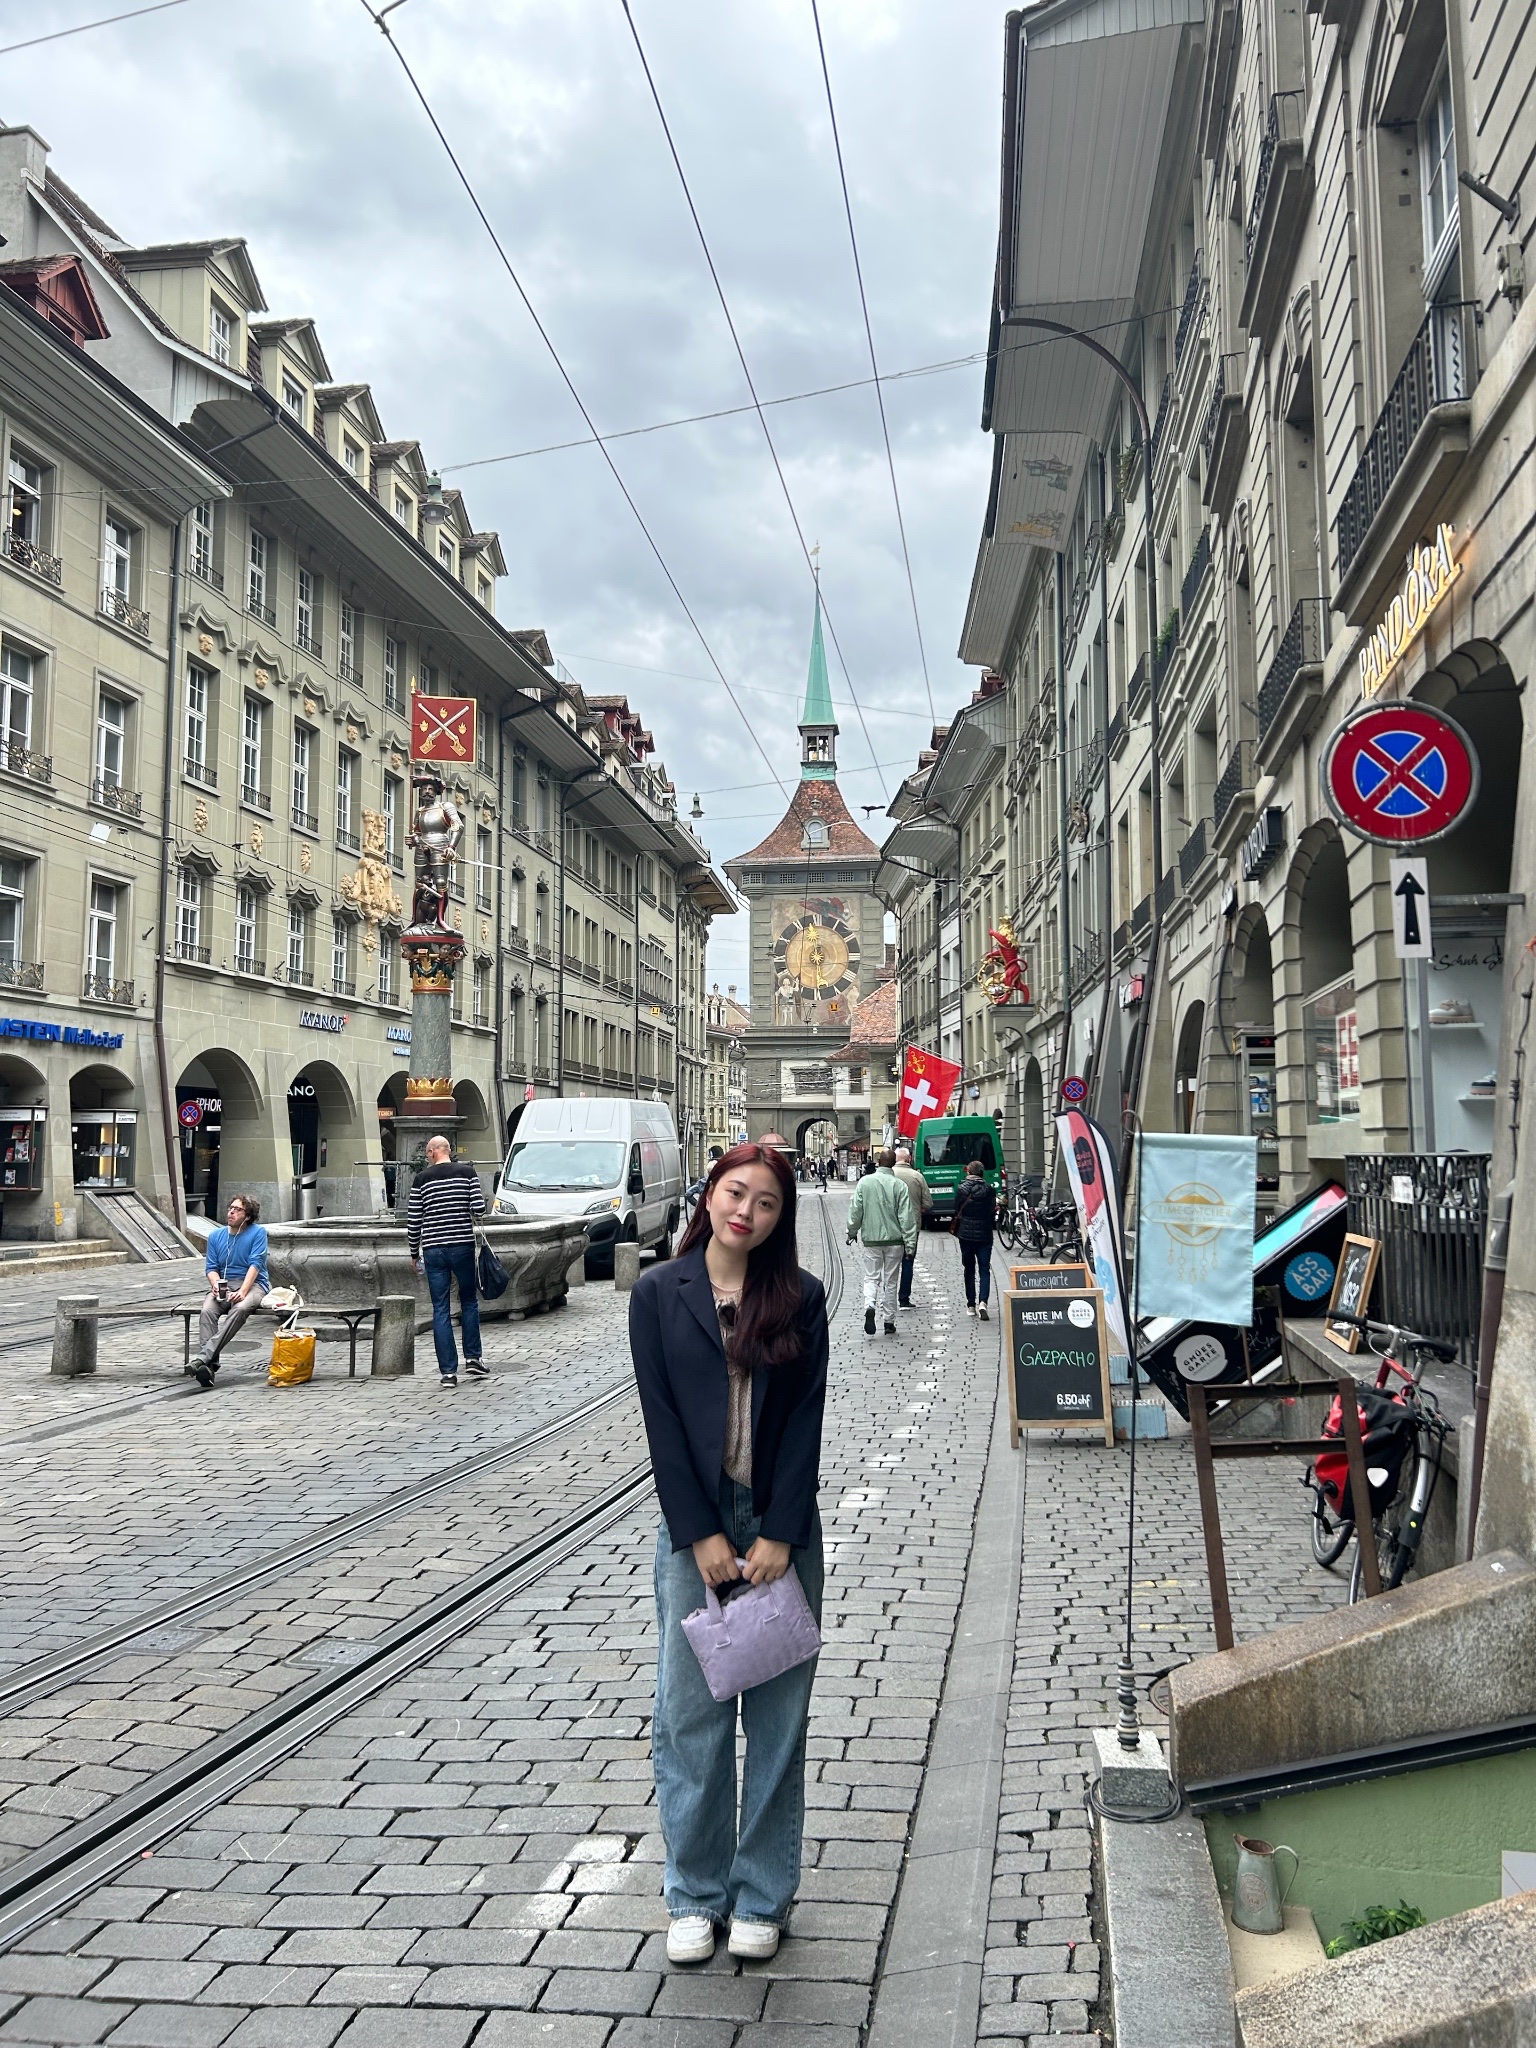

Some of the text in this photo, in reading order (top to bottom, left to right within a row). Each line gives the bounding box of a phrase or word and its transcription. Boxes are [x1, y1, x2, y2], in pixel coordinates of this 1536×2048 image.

[1358, 523, 1456, 699] PANDORA
[1433, 954, 1479, 971] Schuh
[300, 1009, 345, 1033] MANOR
[1289, 1256, 1319, 1286] ÄSS
[1301, 1268, 1332, 1296] BAR
[1021, 1310, 1063, 1321] HEUTE IM
[1183, 1342, 1213, 1366] GMÜES
[1187, 1348, 1217, 1372] GARTE
[1056, 1393, 1077, 1406] 6.50
[1077, 1394, 1092, 1409] chf
